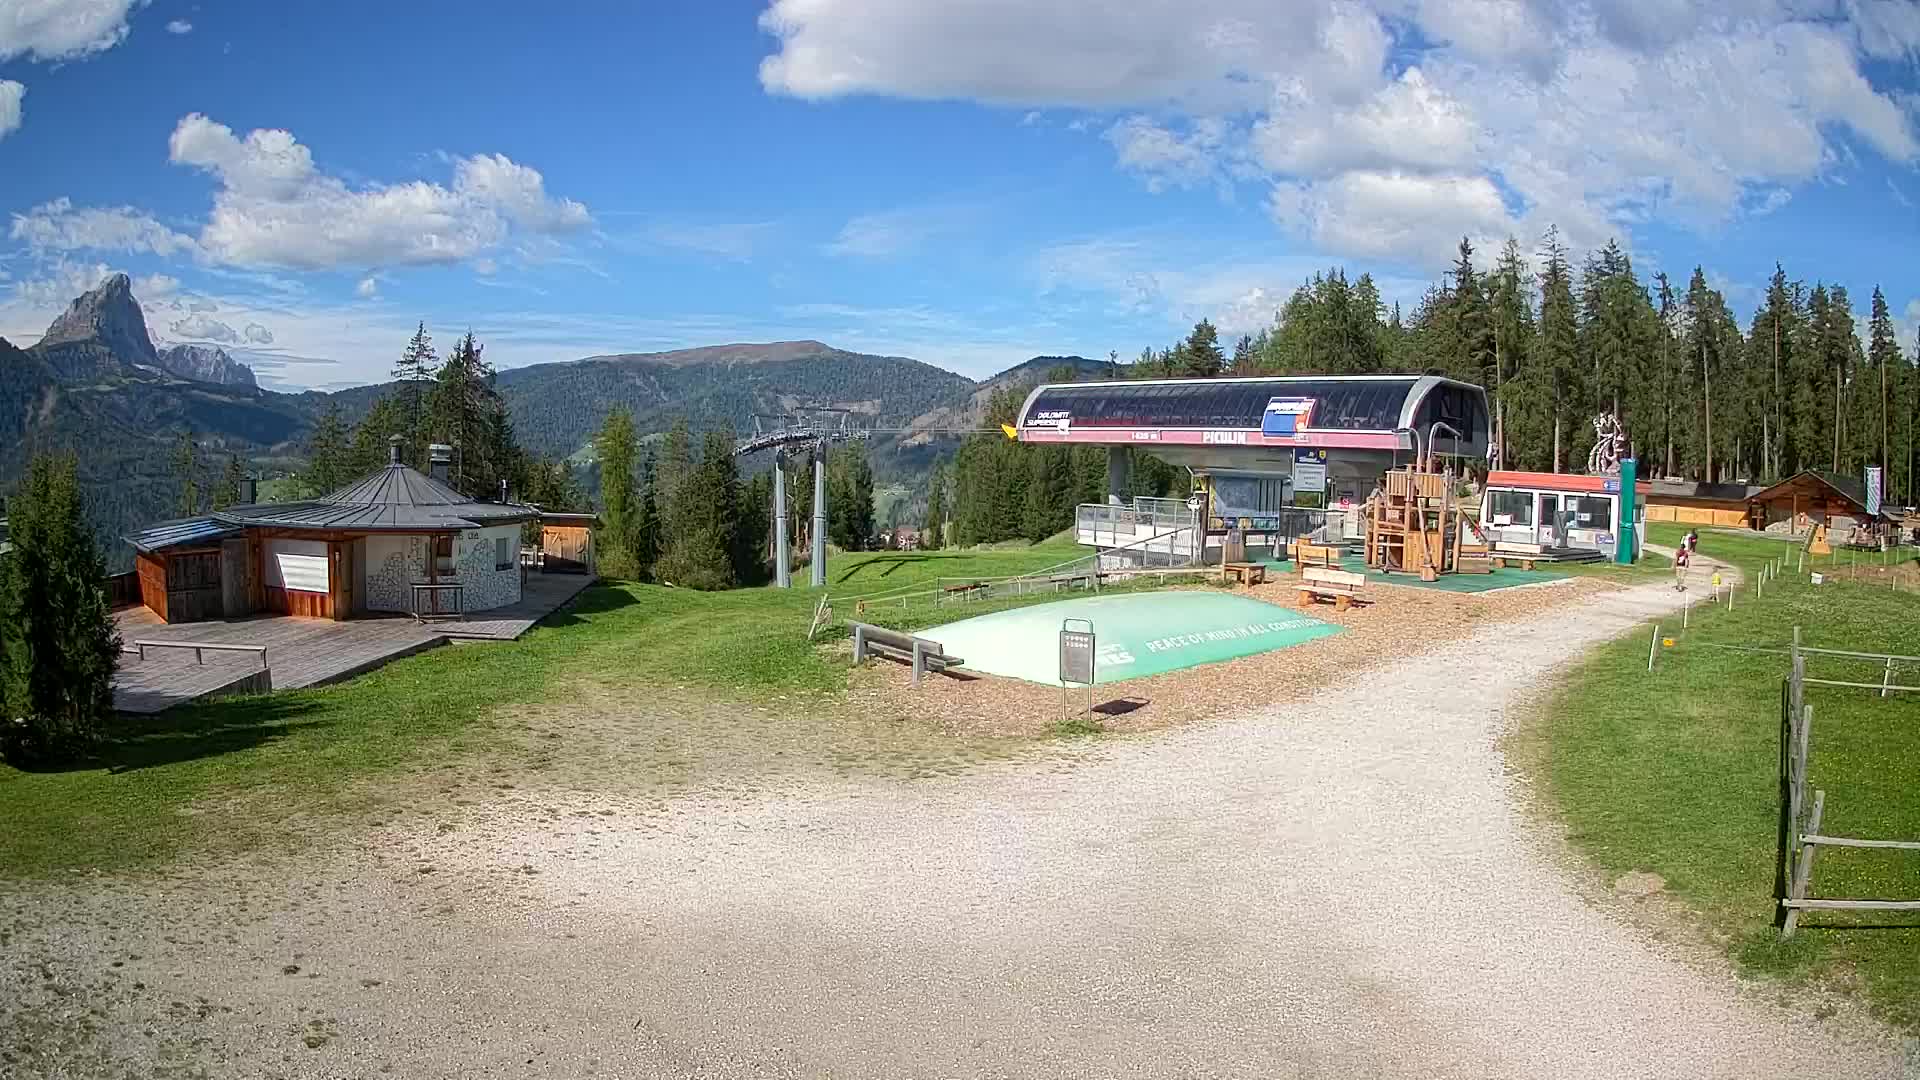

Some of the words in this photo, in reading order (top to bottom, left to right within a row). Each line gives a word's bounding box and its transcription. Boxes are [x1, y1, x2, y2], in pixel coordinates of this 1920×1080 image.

[1202, 431, 1247, 444] PICULIN
[1145, 635, 1187, 653] PEACE
[1188, 632, 1206, 644] OF
